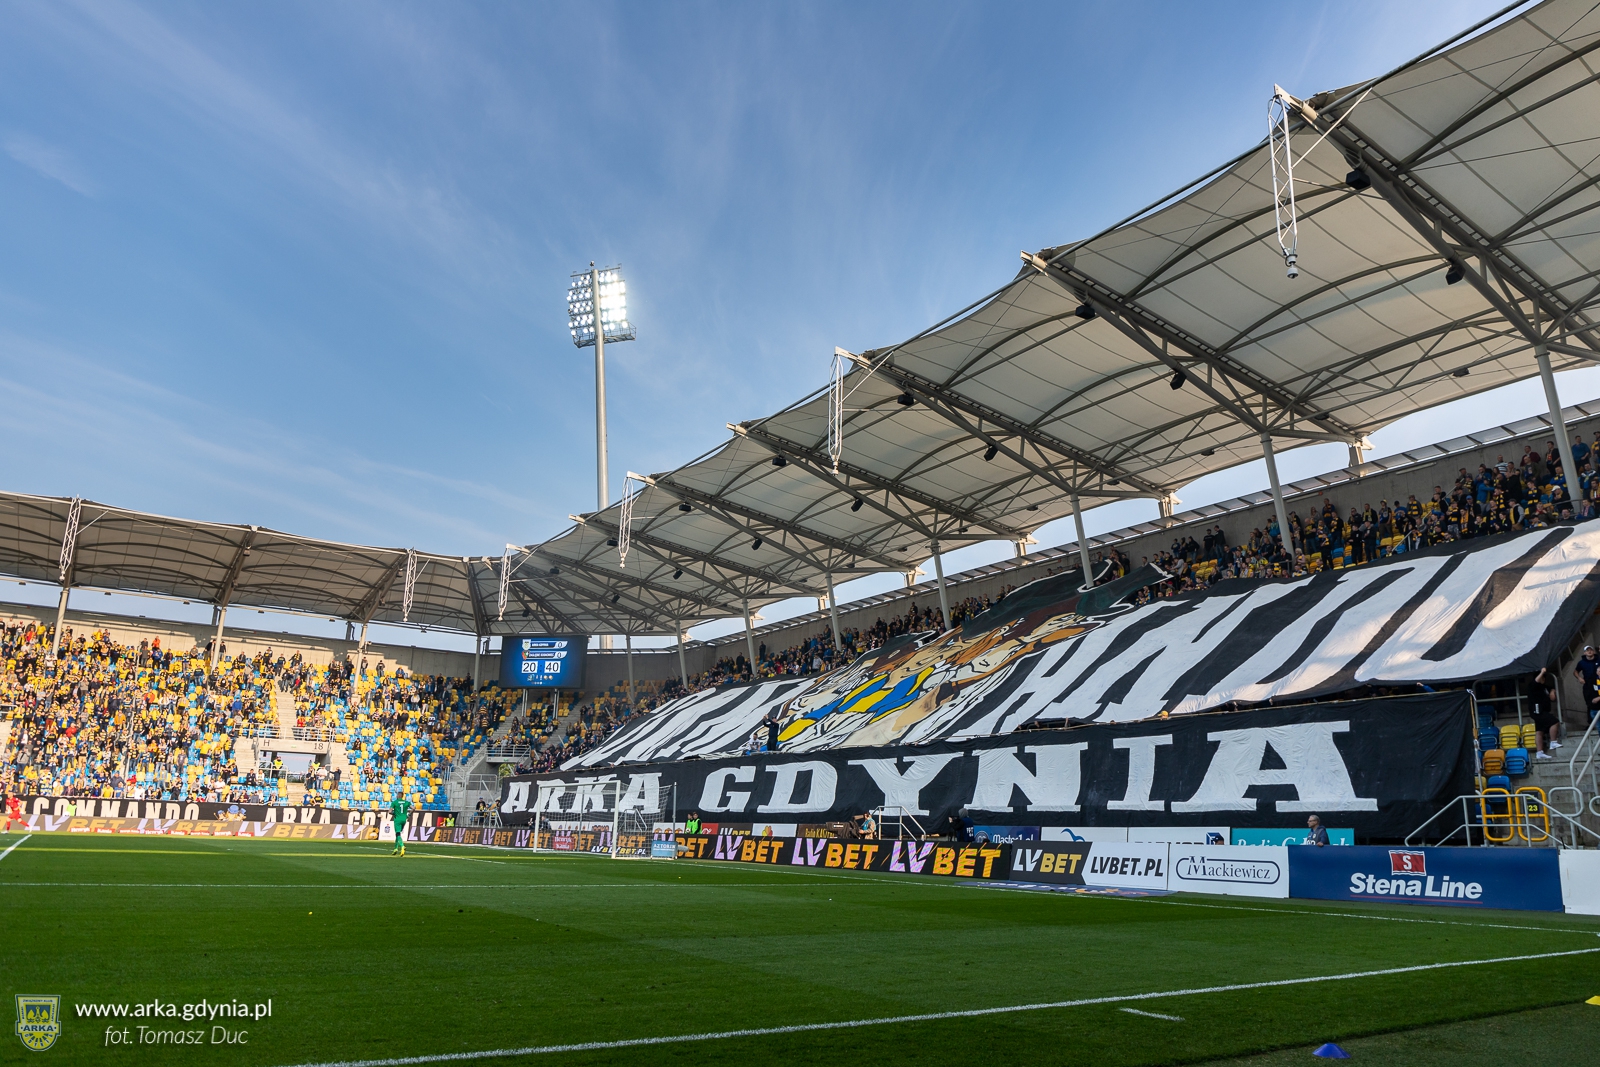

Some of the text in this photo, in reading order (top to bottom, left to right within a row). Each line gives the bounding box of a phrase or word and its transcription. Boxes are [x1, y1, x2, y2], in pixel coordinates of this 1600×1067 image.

[523, 662, 559, 672] 20 40
[501, 720, 1379, 816] ARKA GDYNIA
[33, 797, 432, 827] COMMANDO ARKA GDYIA
[400, 804, 404, 814] 1
[1090, 856, 1164, 878] LVBET.PL
[1187, 856, 1270, 880] Mackiewicz
[1403, 855, 1412, 870] S
[1349, 872, 1483, 900] Stena Line
